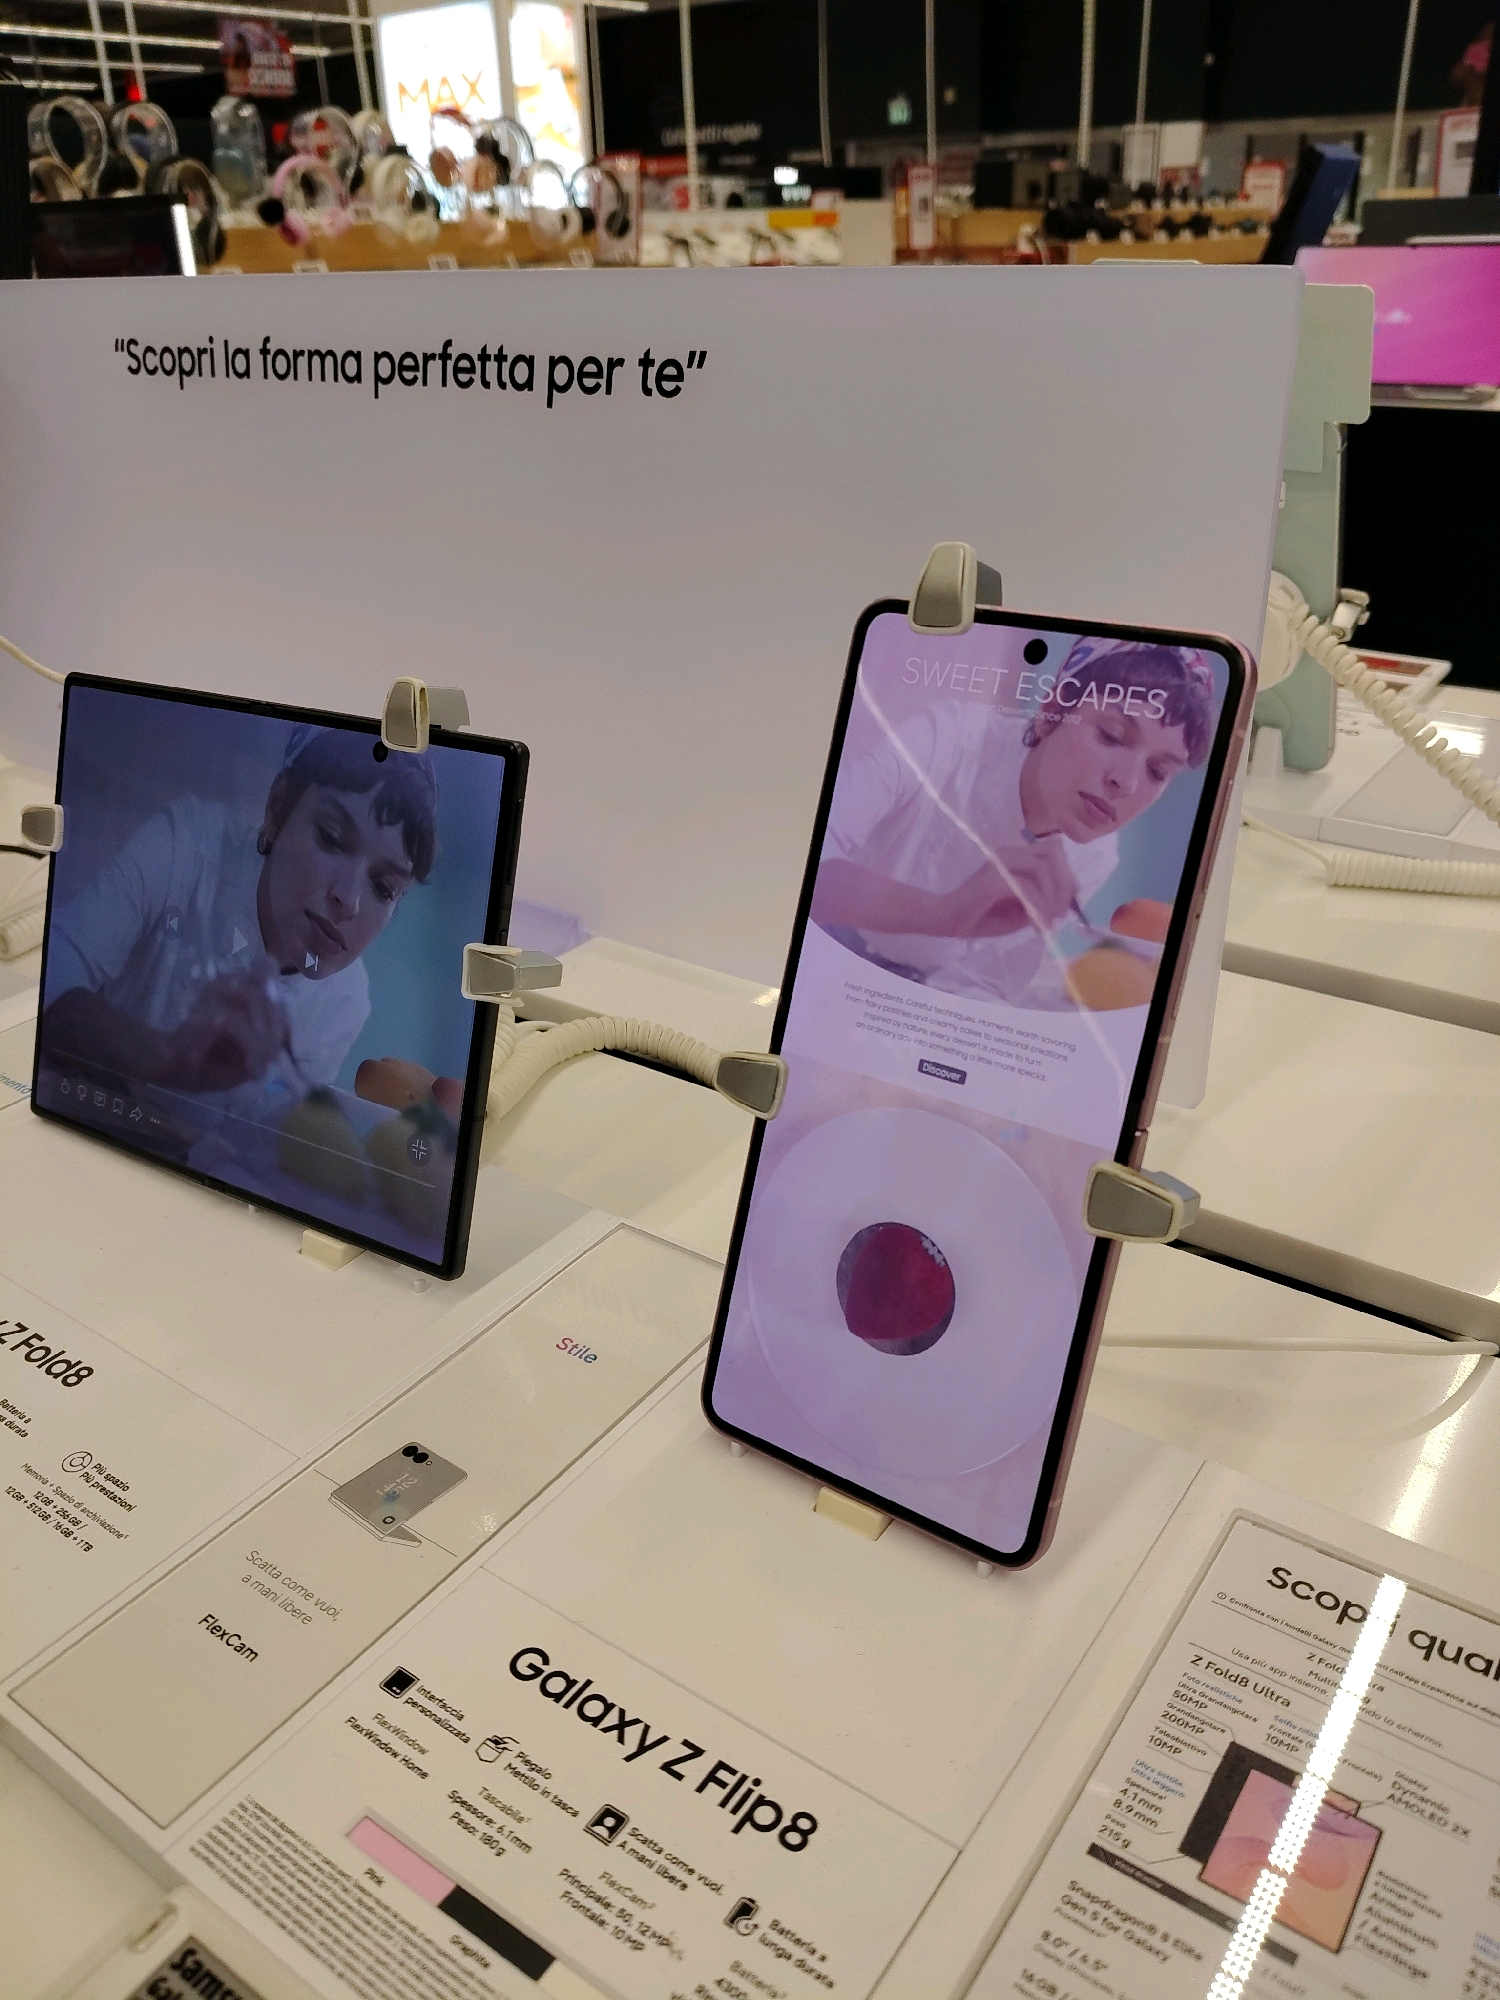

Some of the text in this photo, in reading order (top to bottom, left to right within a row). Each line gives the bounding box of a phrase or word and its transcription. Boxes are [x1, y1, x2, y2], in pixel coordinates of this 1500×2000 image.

[398, 70, 486, 114] MAX
[224, 341, 251, 380] la
[259, 336, 362, 384] forma
[374, 339, 535, 399] perfetta
[546, 350, 625, 409] per
[902, 657, 1008, 695] SWEET
[1015, 671, 1168, 720] ESCAPES
[922, 1062, 961, 1082] Discover
[9, 1332, 94, 1388] Fold8
[556, 1337, 598, 1364] Stile
[4, 1418, 29, 1438] durata
[20, 1462, 49, 1486] Memoria
[52, 1485, 75, 1505] Spazio
[89, 1480, 138, 1513] prestazioni
[104, 1473, 130, 1492] spazio
[241, 1574, 313, 1625] a mani libere
[246, 1550, 343, 1622] Scatta come vuoi,
[1266, 1566, 1400, 1637] Scopi
[198, 1613, 259, 1663] FlexCam
[1306, 1652, 1316, 1662] Z
[1182, 1671, 1201, 1685] Foto
[1190, 1654, 1291, 1708] Z Fold8 Ultra
[1231, 1647, 1250, 1661] Usa
[1269, 1666, 1287, 1678] app
[402, 1696, 471, 1744] personalizzata
[416, 1685, 465, 1722] Interfaccia
[1166, 1702, 1226, 1734] Grandangolare
[1172, 1690, 1208, 1710] 50MP
[1177, 1680, 1259, 1723] Ultra Grandangolare
[372, 1712, 430, 1756] FlexWindow
[1153, 1725, 1207, 1757] Teleobiettivo
[1161, 1710, 1205, 1735] 200MP
[344, 1716, 429, 1780] FlexWindow Home
[509, 1646, 818, 1853] Galaxy Z Flip8
[1148, 1734, 1182, 1755] 10MP
[1265, 1733, 1299, 1754] 10MP
[514, 1751, 552, 1780] Piegalo
[446, 1790, 496, 1829] Spessore:
[502, 1762, 580, 1818] Mettilo in tasca
[450, 1811, 479, 1837] Peso:
[625, 1847, 655, 1869] mani
[652, 1864, 689, 1891] libere
[628, 1826, 664, 1856] Scatta
[663, 1850, 696, 1877] come
[364, 1867, 386, 1887] Pink
[557, 1867, 616, 1912] Principale:
[560, 1890, 609, 1930] Frontale:
